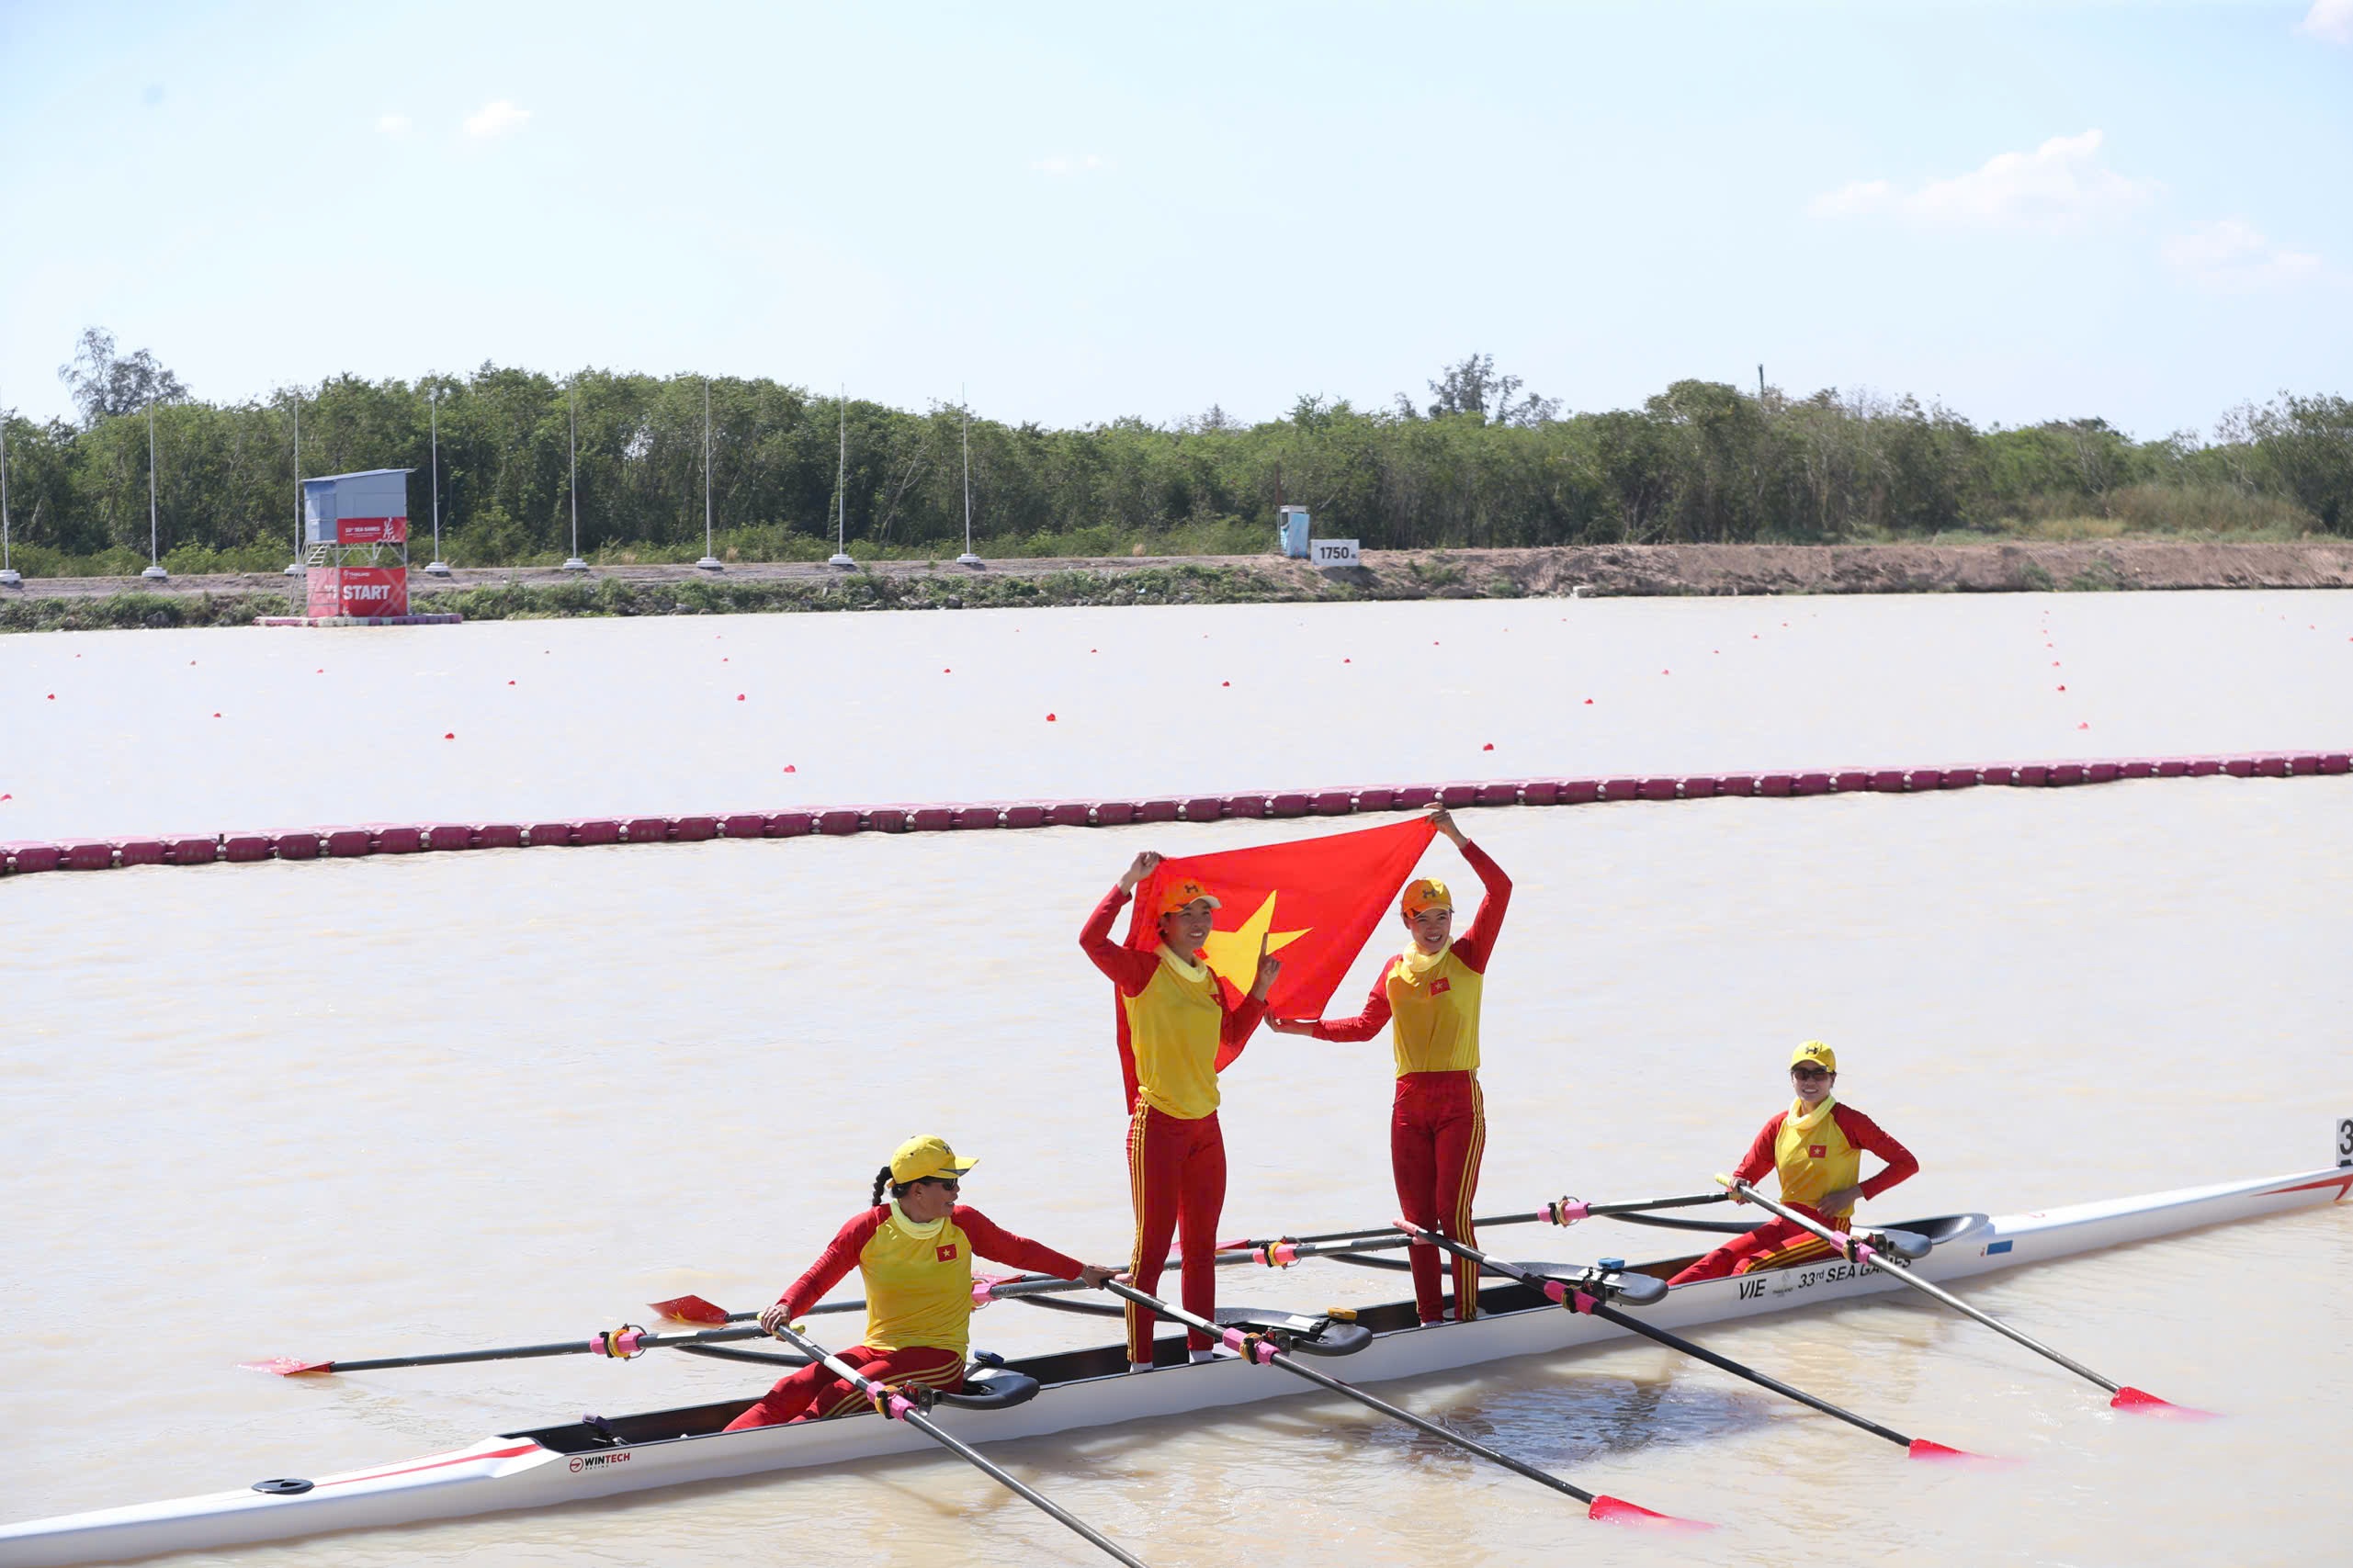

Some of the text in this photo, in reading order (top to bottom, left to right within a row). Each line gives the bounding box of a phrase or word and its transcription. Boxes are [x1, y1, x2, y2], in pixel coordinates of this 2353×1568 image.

[1320, 547, 1349, 558] 1750
[343, 585, 390, 600] START
[2339, 1119, 2353, 1156] 3
[1738, 1256, 1912, 1301] VIE 33rd SEA GAES
[585, 1452, 630, 1466] WINTECH
